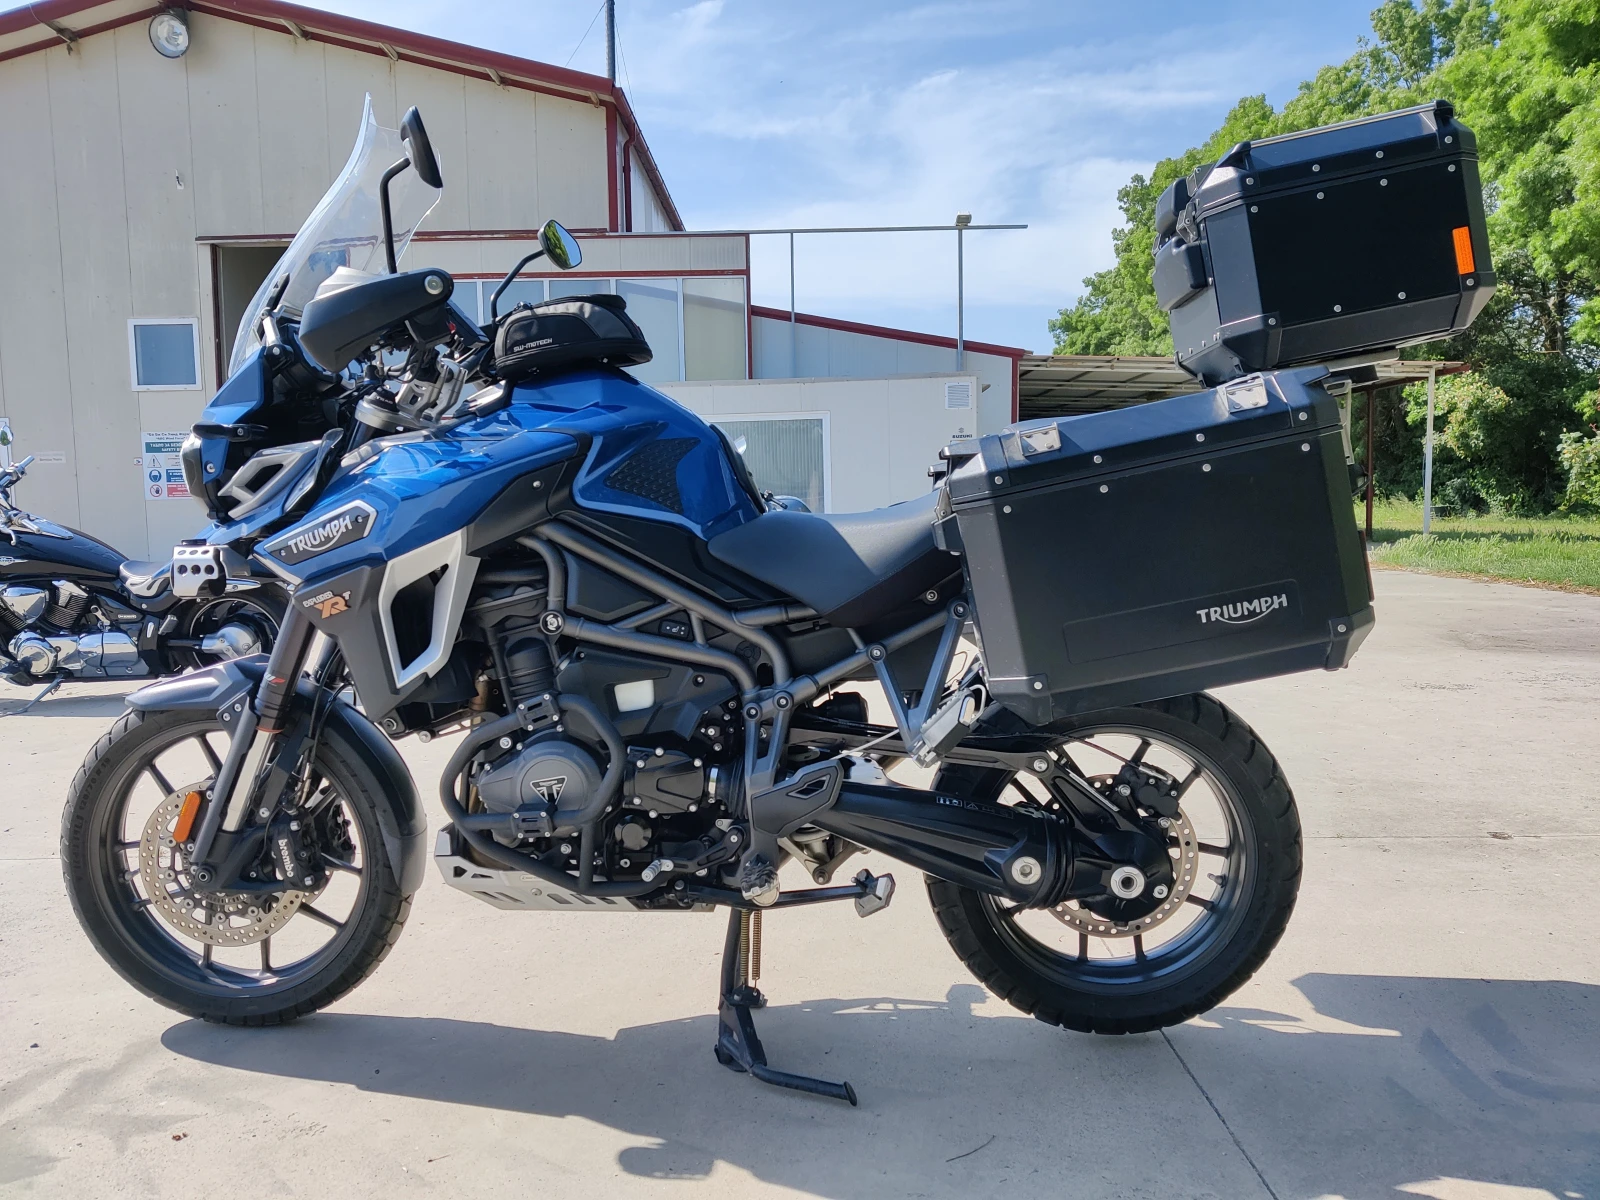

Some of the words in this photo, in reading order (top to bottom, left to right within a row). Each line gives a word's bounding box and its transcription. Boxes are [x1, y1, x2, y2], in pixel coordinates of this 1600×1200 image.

[513, 337, 553, 352] SW-MOTECH
[287, 514, 353, 554] TRIUMPH
[1196, 594, 1288, 624] TRIUMPH
[278, 839, 294, 878] brembo
